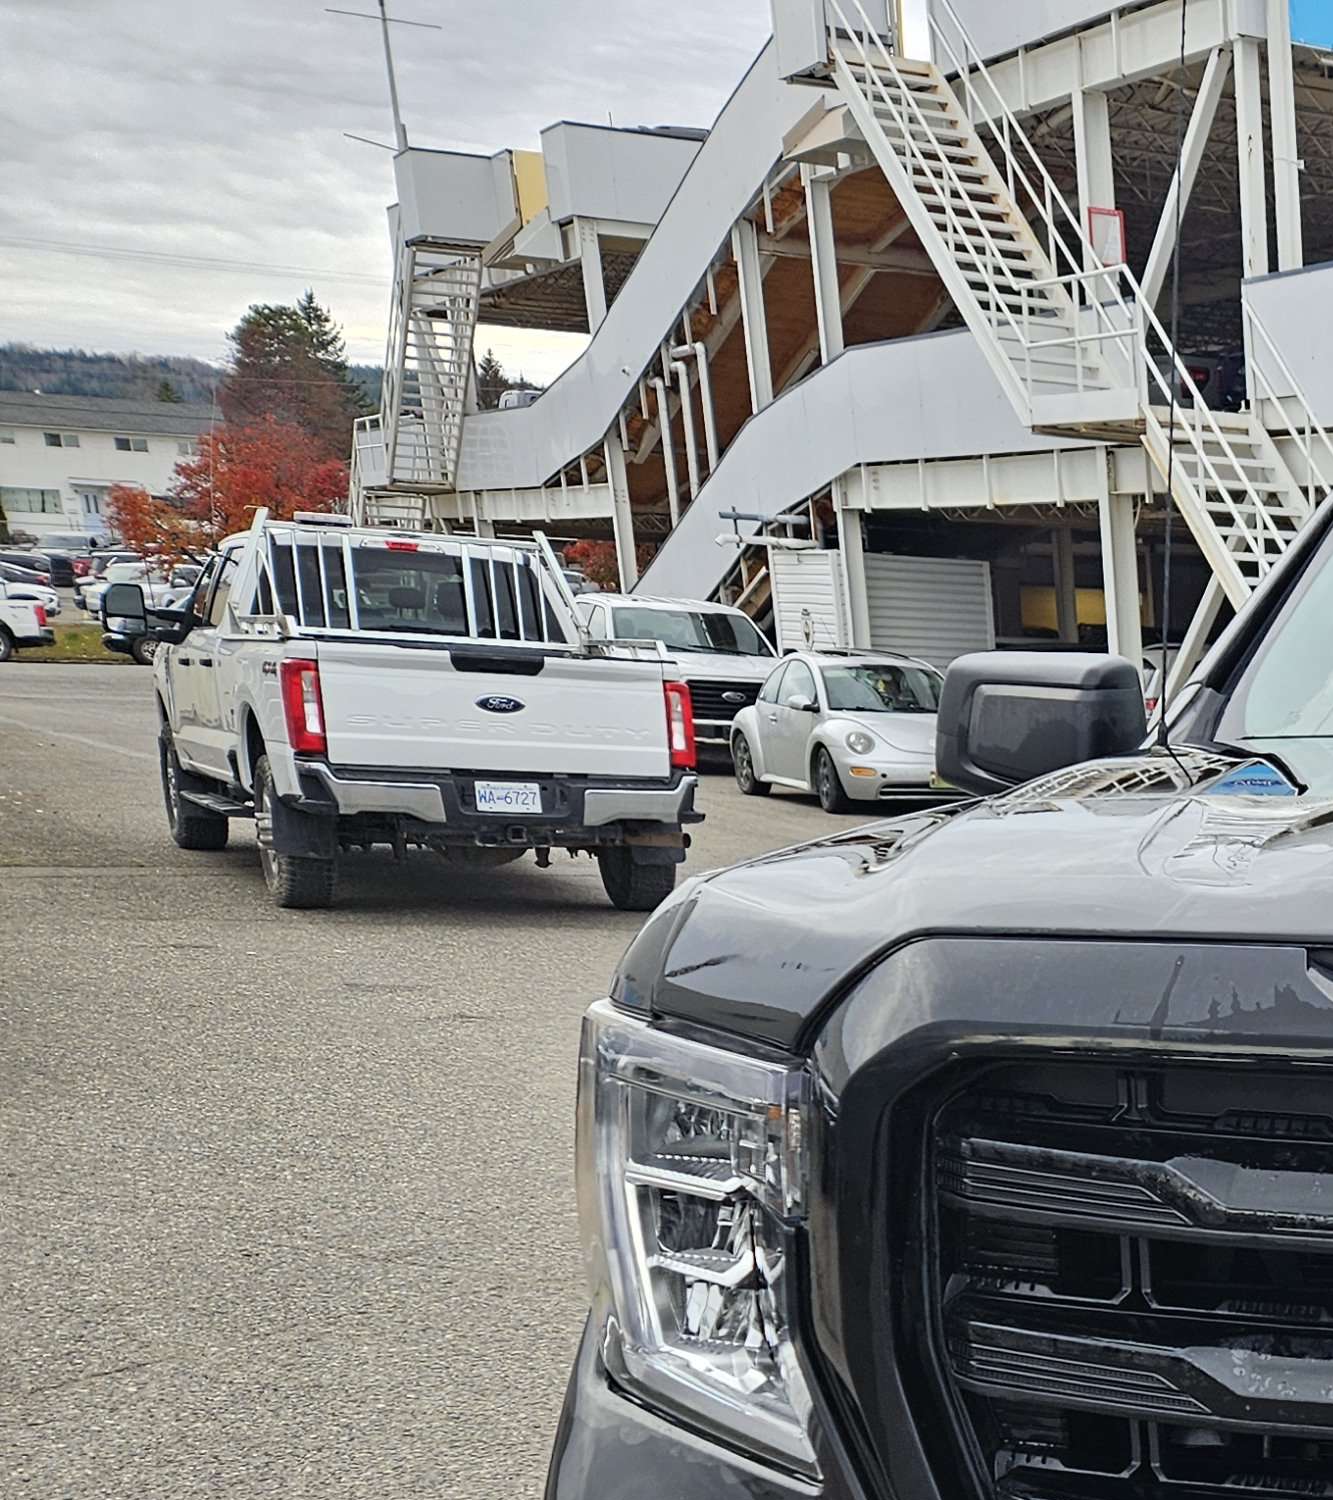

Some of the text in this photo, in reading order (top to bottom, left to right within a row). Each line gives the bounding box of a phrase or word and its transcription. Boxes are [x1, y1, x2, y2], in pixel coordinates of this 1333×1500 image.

[345, 712, 651, 740] SUPER DUTY
[478, 789, 537, 806] WA-6727
